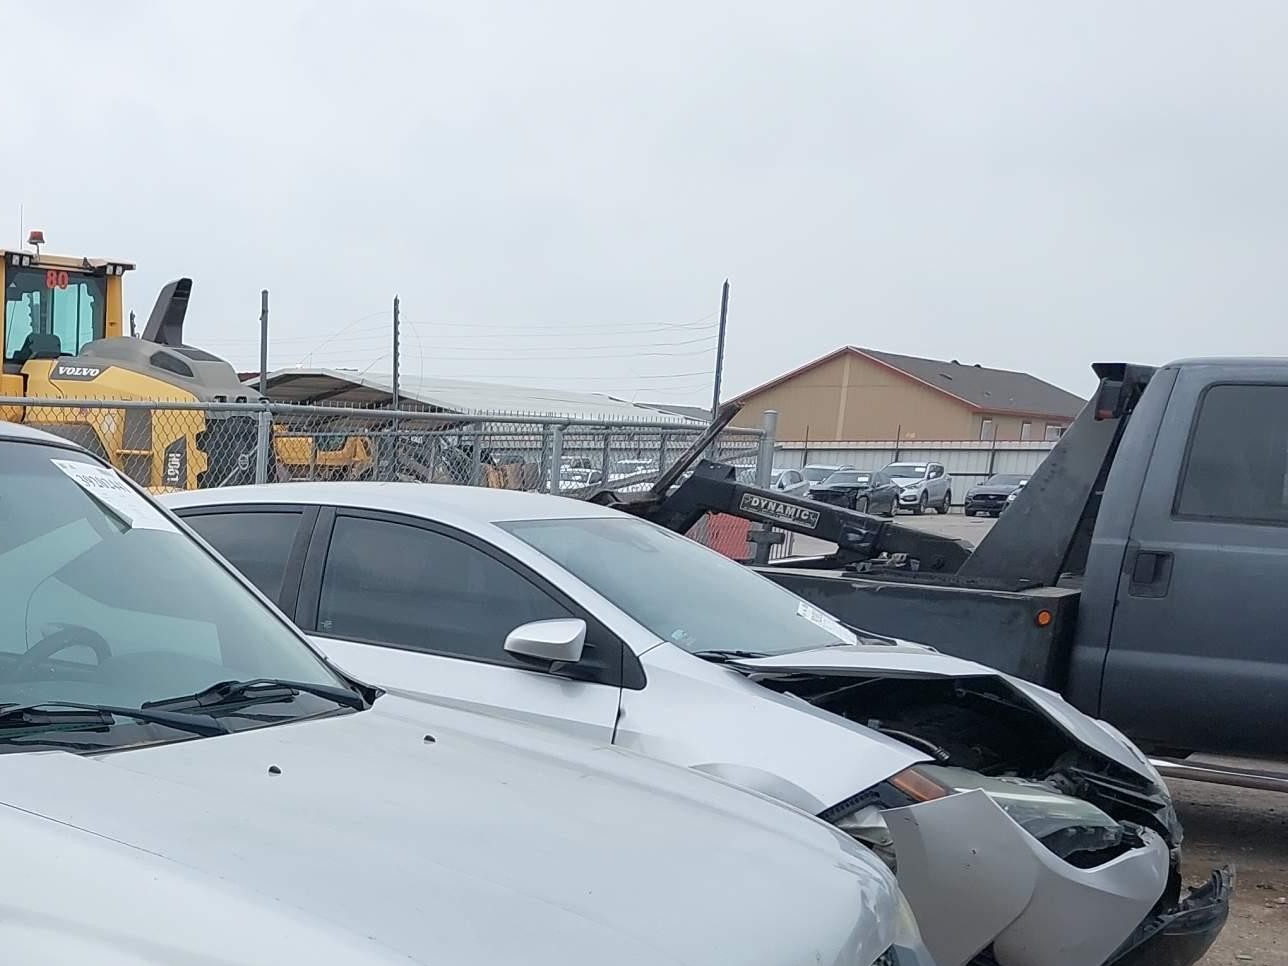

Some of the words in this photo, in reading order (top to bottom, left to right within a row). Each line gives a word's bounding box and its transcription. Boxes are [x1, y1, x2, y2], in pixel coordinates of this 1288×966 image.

[47, 270, 69, 289] 80
[58, 366, 100, 377] VOLVO
[166, 453, 181, 482] L90H
[751, 497, 810, 520] DYNAMIC
